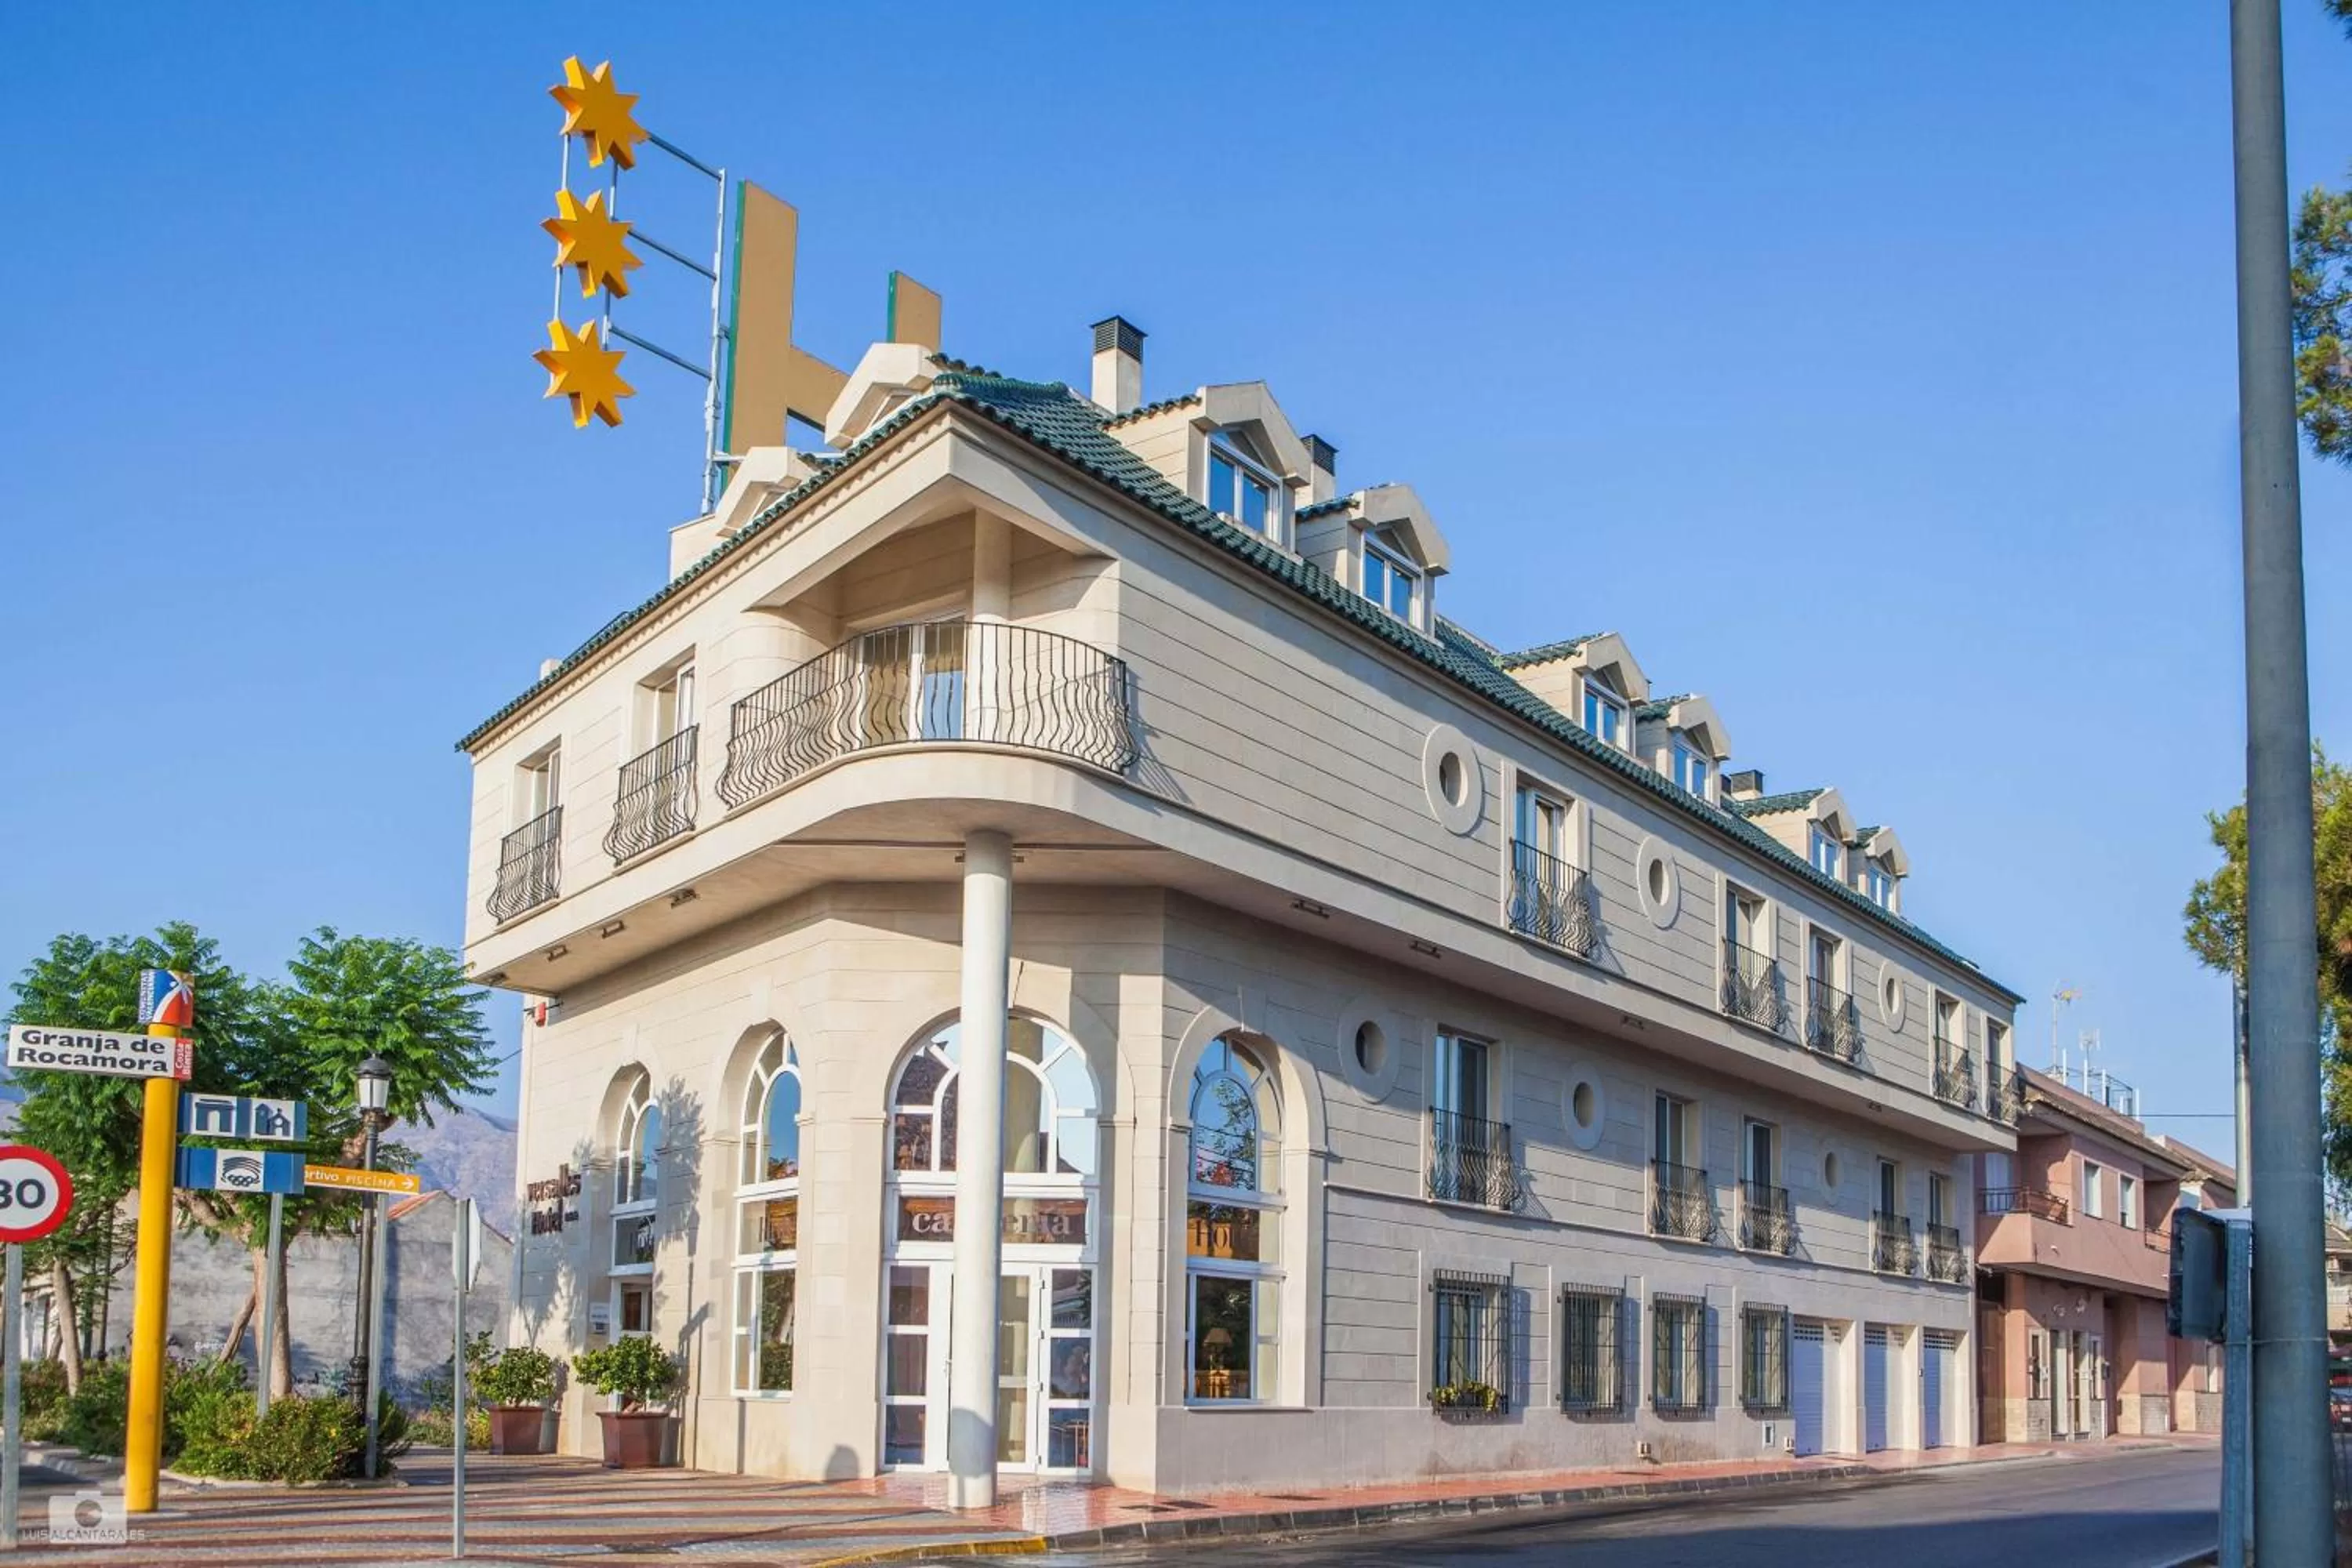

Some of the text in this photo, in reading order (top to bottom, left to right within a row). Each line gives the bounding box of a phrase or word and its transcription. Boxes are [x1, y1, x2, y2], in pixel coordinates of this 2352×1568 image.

[22, 1030, 165, 1054] Granja de
[17, 1047, 168, 1072] Rocamora
